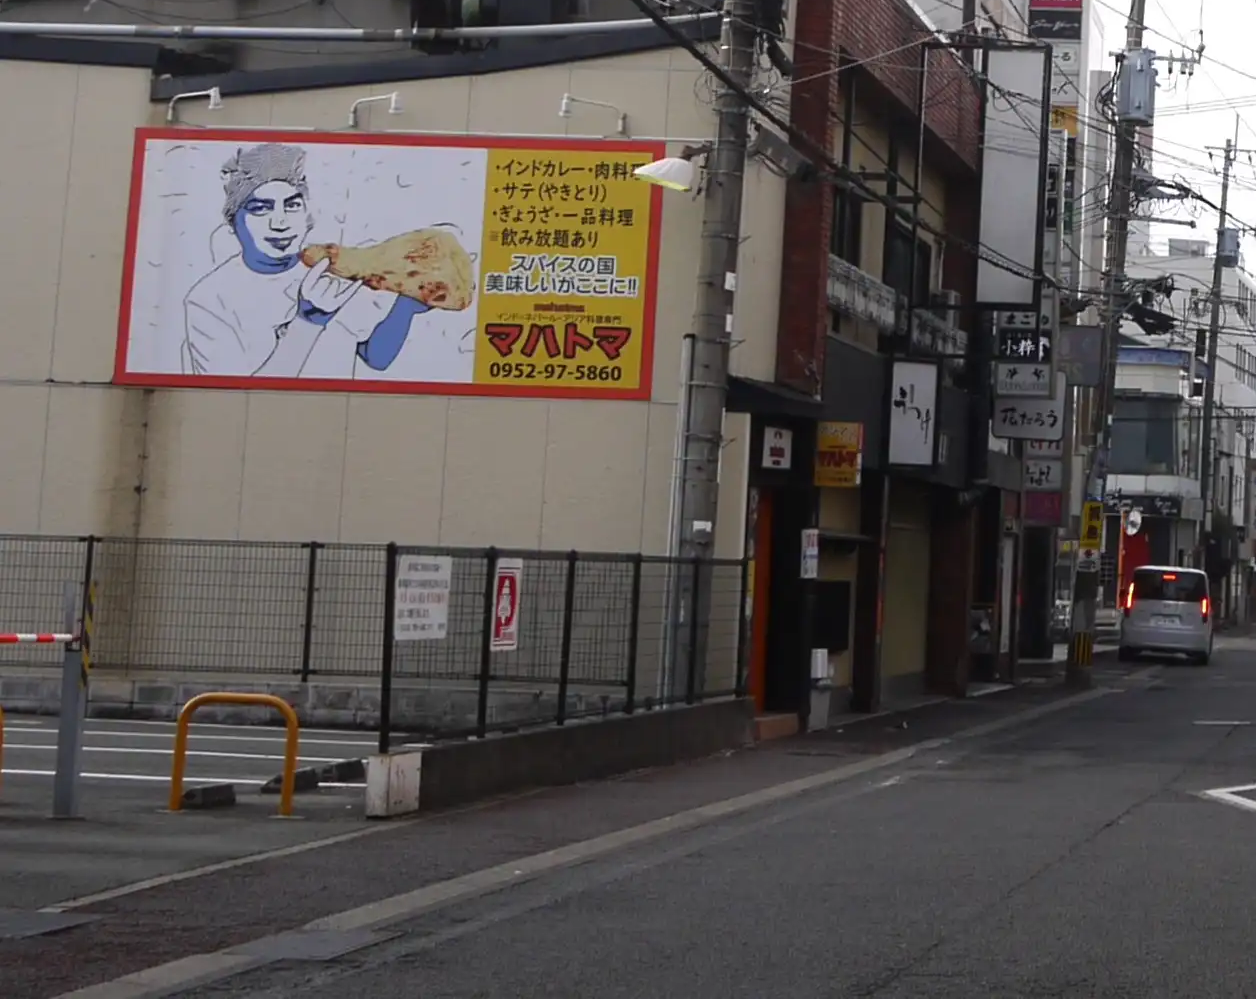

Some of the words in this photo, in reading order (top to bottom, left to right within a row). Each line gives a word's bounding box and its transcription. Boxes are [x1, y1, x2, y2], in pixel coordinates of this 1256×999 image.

[511, 255, 615, 276] スパイスの国
[485, 323, 631, 360] マハトマ
[489, 362, 622, 381] 0952-97-5860
